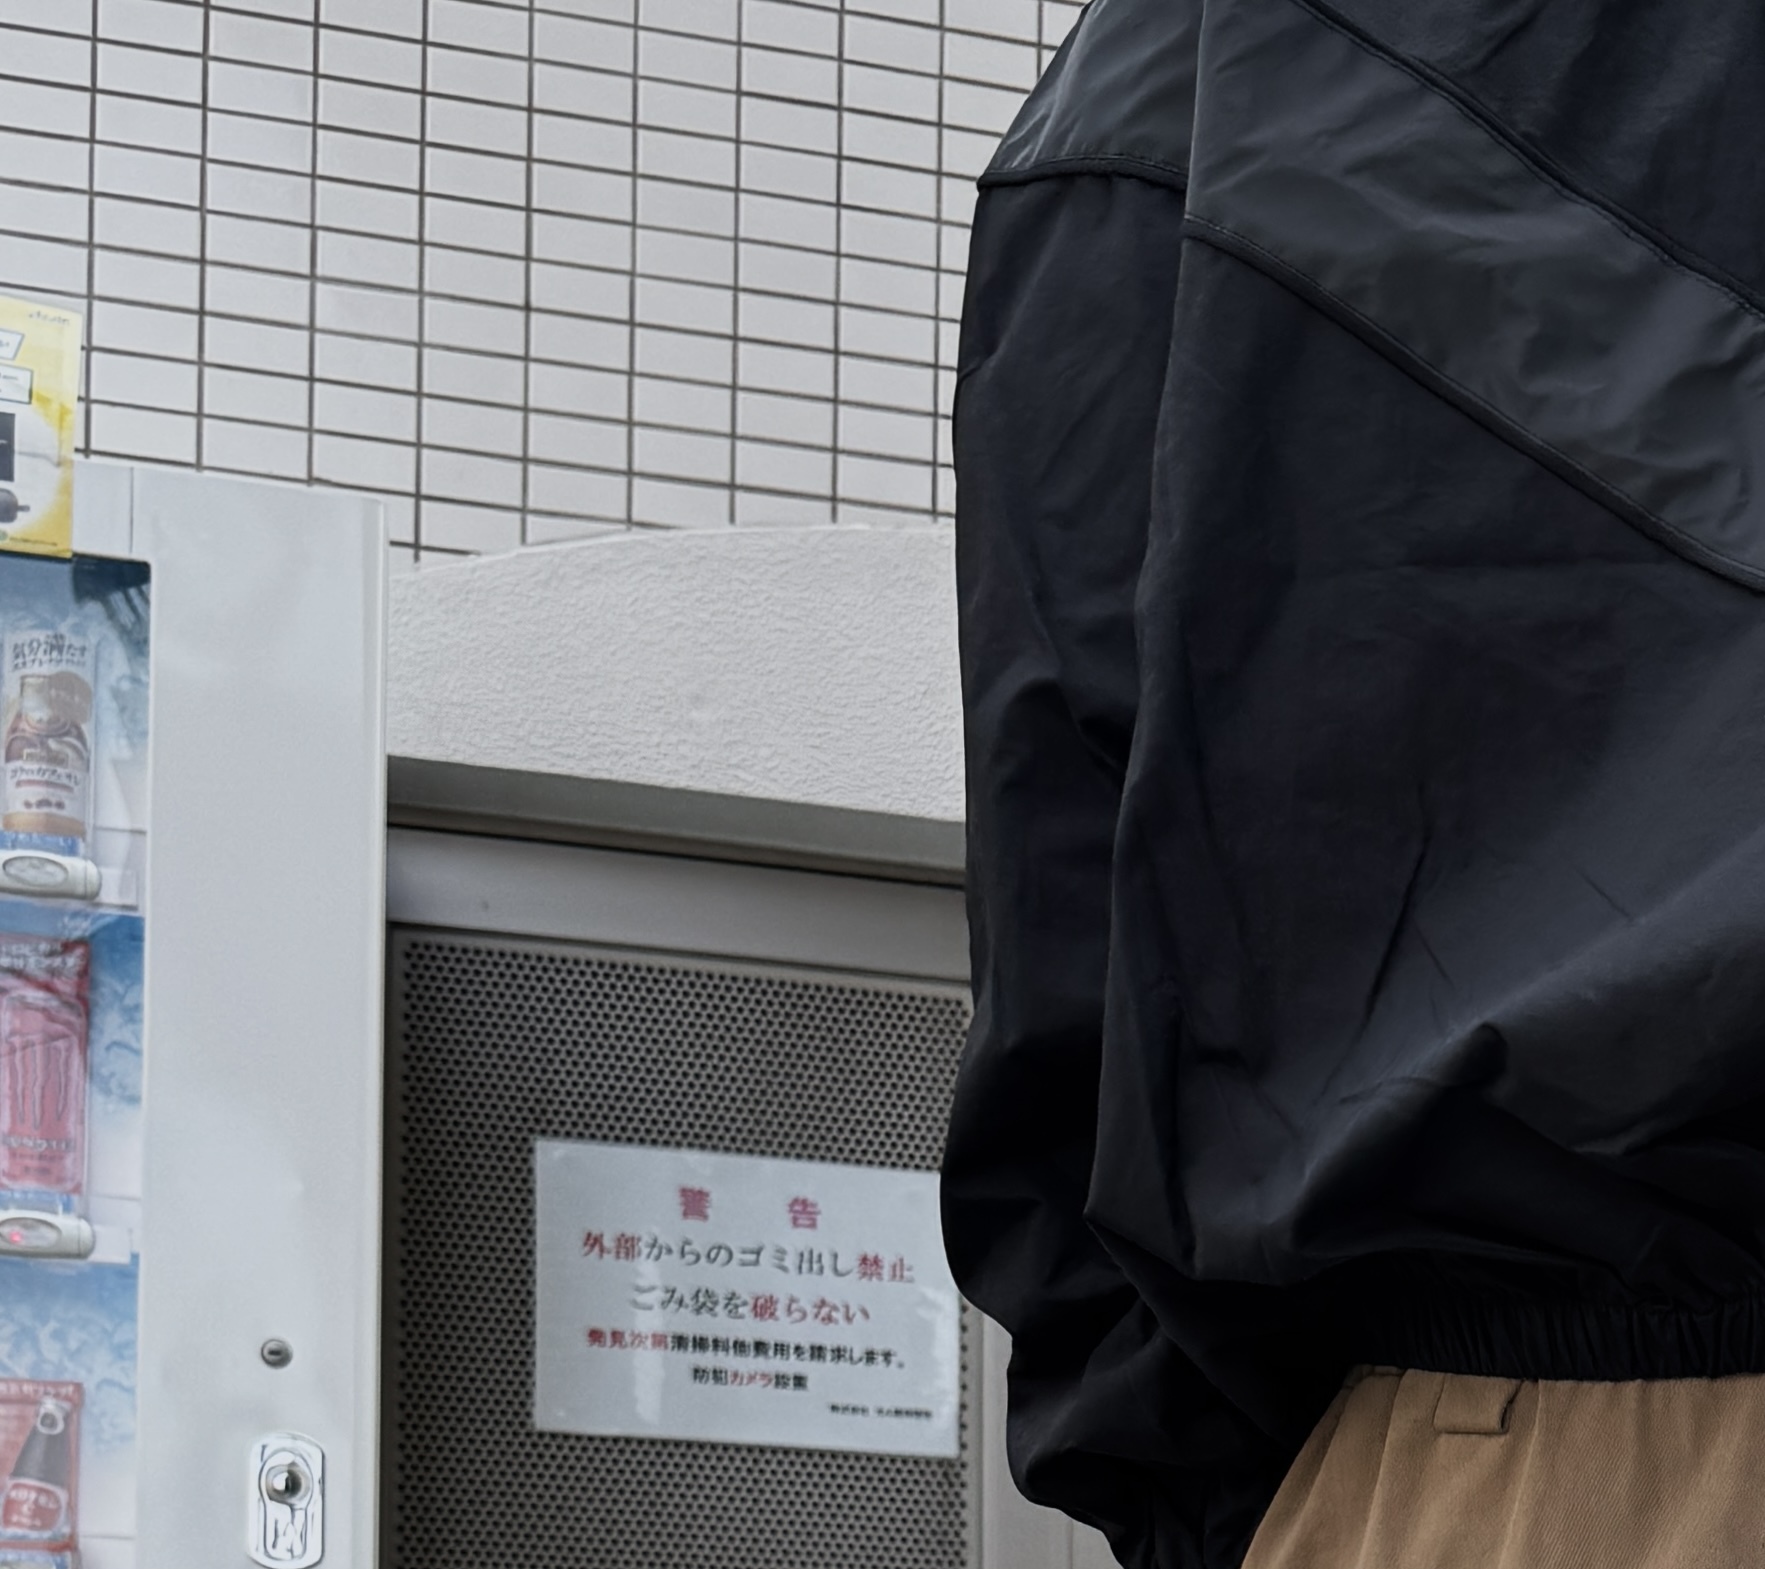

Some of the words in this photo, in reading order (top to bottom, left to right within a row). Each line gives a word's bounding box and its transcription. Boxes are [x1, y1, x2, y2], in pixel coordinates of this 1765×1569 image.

[582, 1231, 914, 1283] 外部からのゴミ出し禁止
[631, 1283, 869, 1325] ごみ袋を破らない
